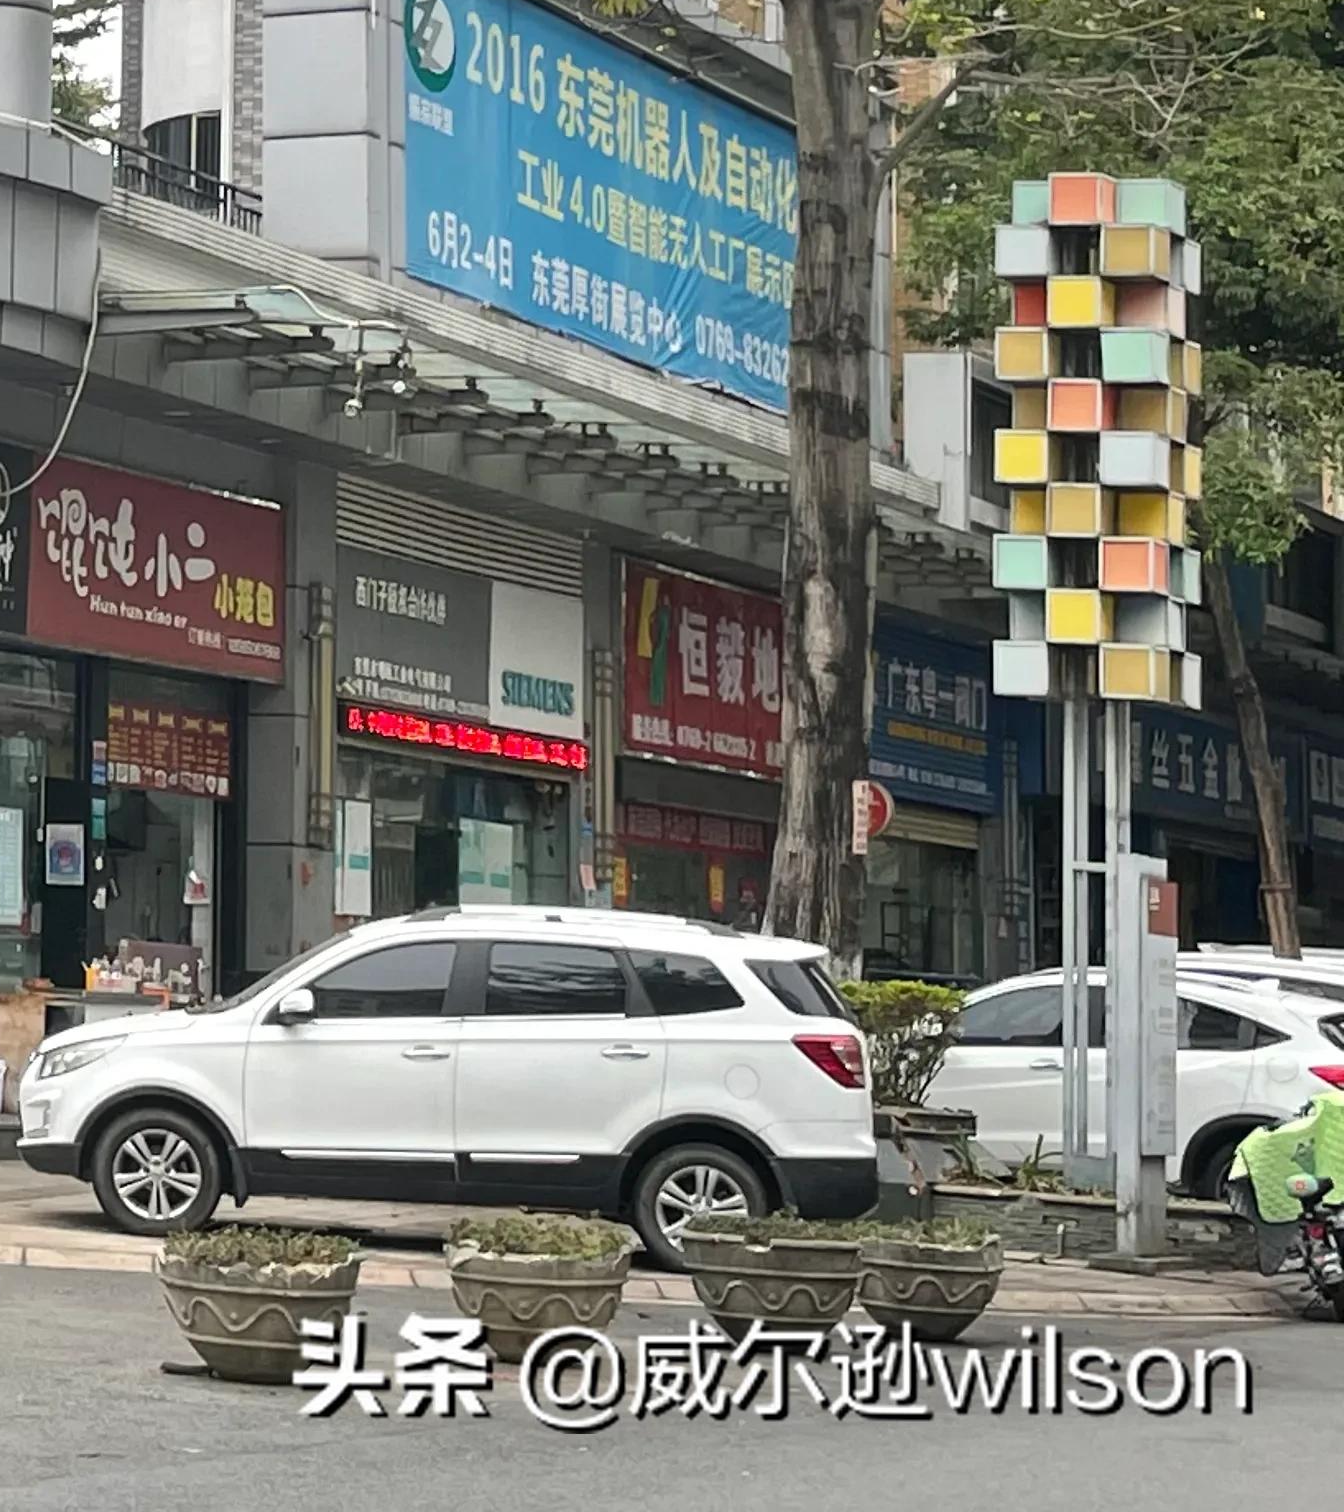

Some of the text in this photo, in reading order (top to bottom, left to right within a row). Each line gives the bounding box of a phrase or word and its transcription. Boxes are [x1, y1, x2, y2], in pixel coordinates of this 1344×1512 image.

[466, 11, 799, 235] 2016 东莞机器人及自动化
[427, 211, 512, 290] 6月2-4日
[531, 250, 683, 354] 东莞厚街展览中心
[500, 670, 575, 717] SIEMENS
